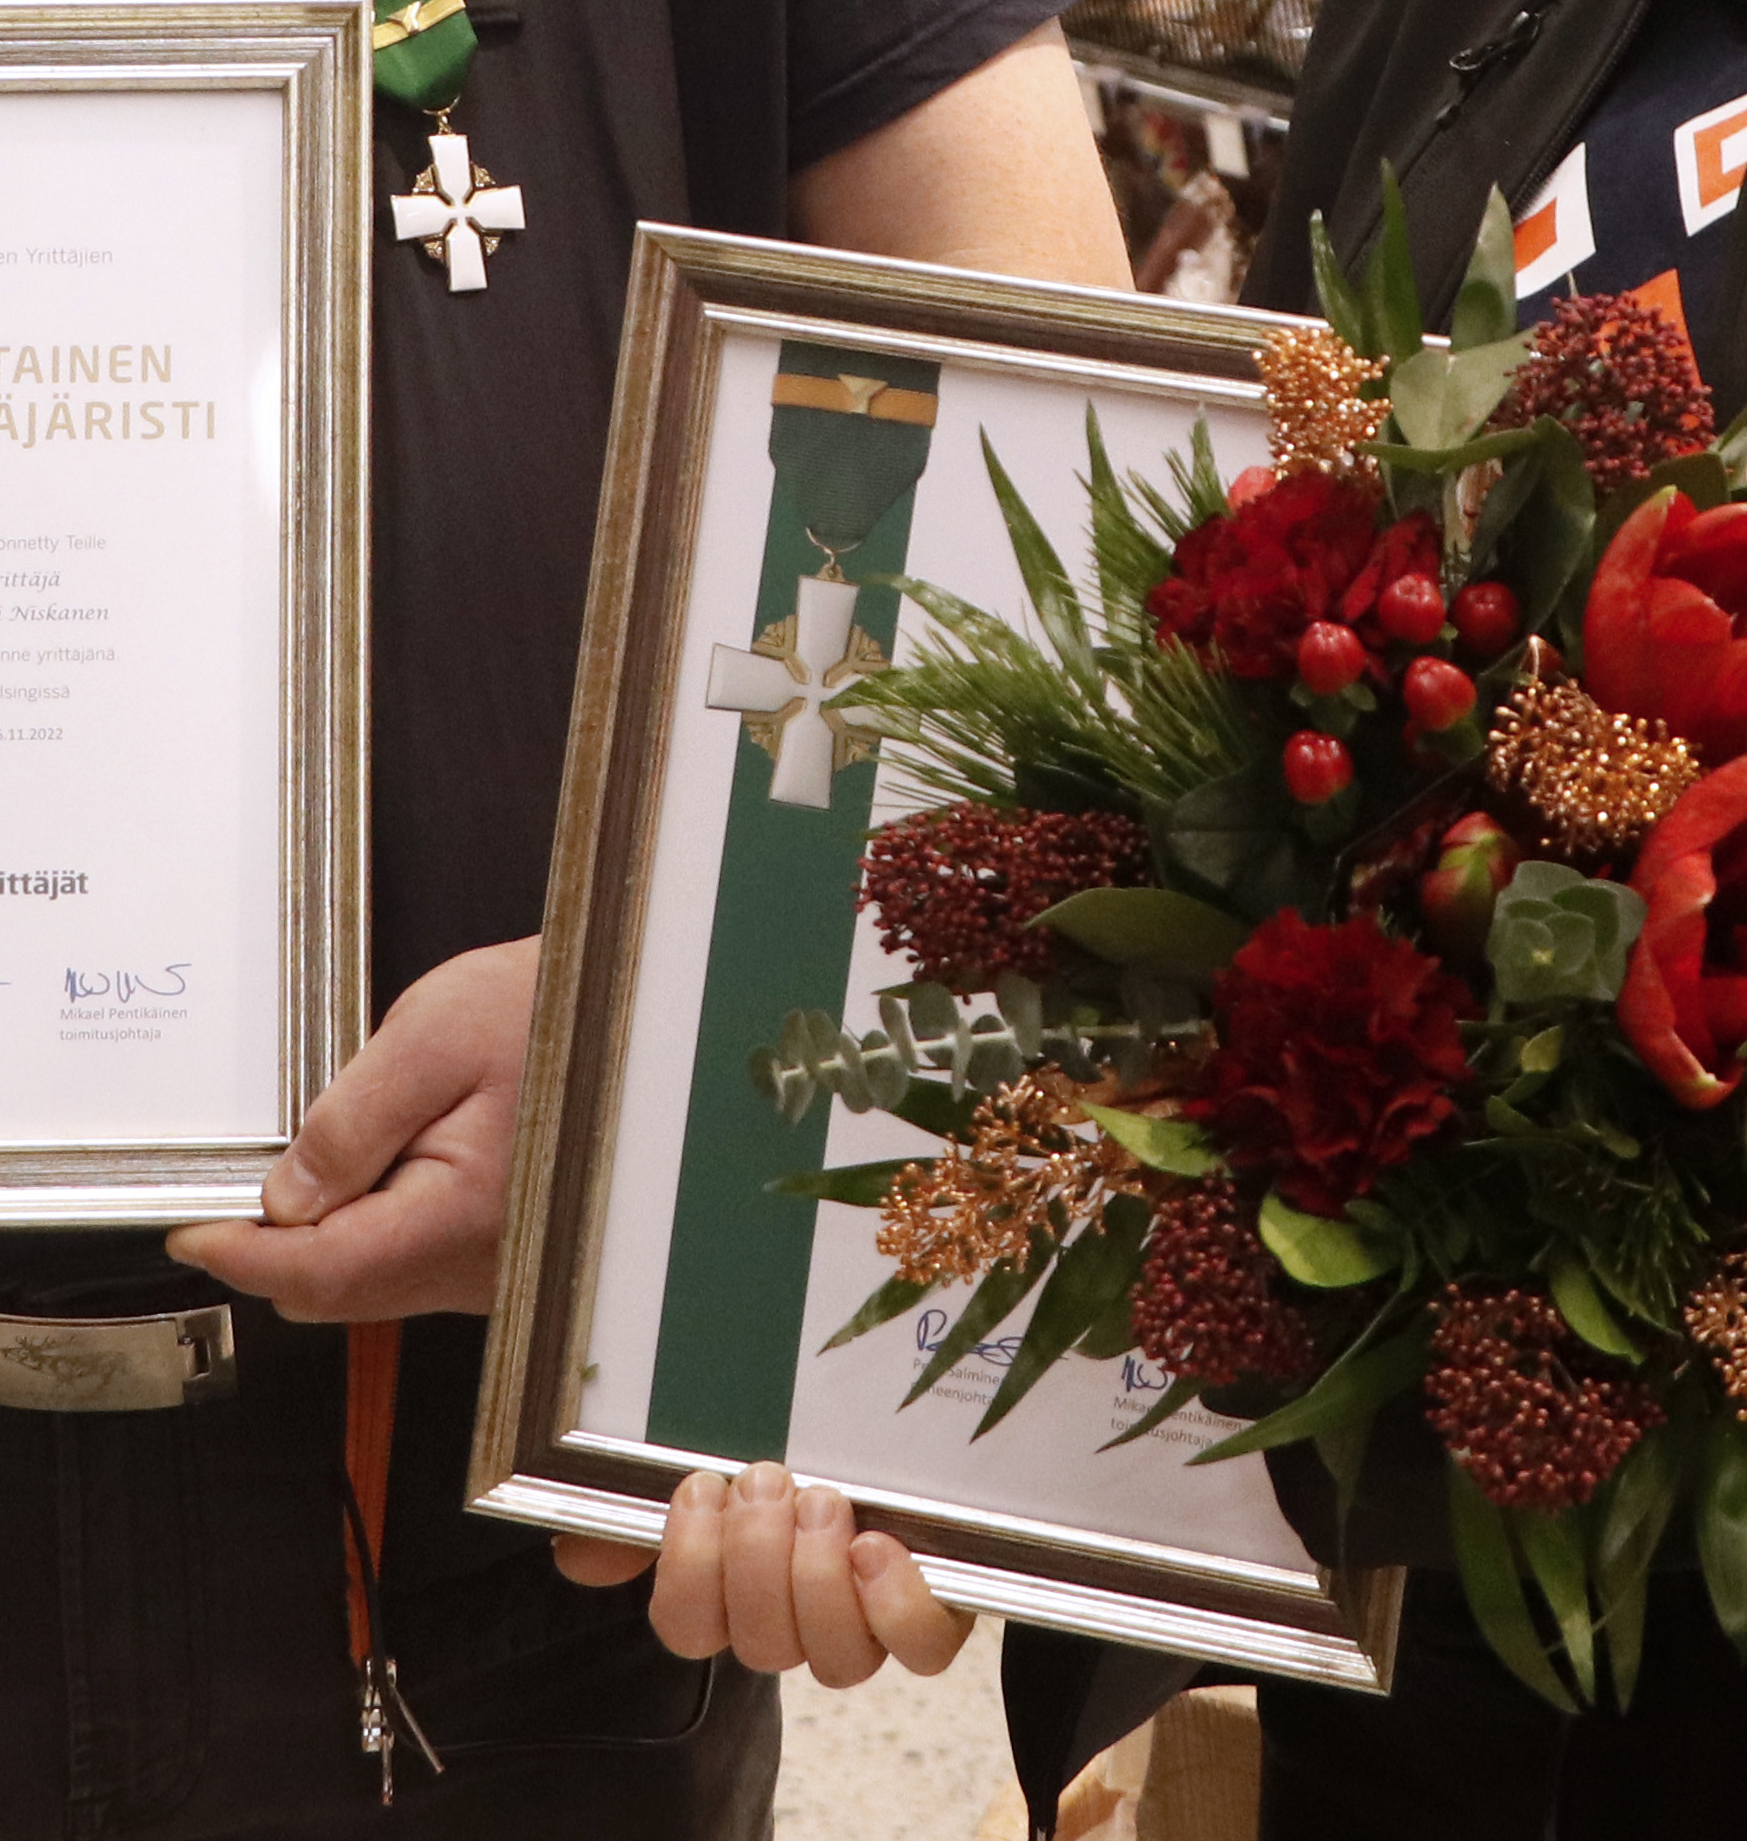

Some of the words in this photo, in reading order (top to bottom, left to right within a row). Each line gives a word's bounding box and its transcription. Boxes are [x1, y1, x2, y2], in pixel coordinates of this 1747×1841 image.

[25, 246, 114, 268] Yrittäjien
[66, 534, 107, 550] Teille
[9, 602, 110, 622] Niskanen
[60, 1008, 105, 1020] Mikael
[108, 1006, 188, 1020] Pentikäinen
[60, 1028, 162, 1044] toimitusjohtaja
[949, 1365, 1000, 1385] Salmine
[1173, 1410, 1242, 1432] entikäinen
